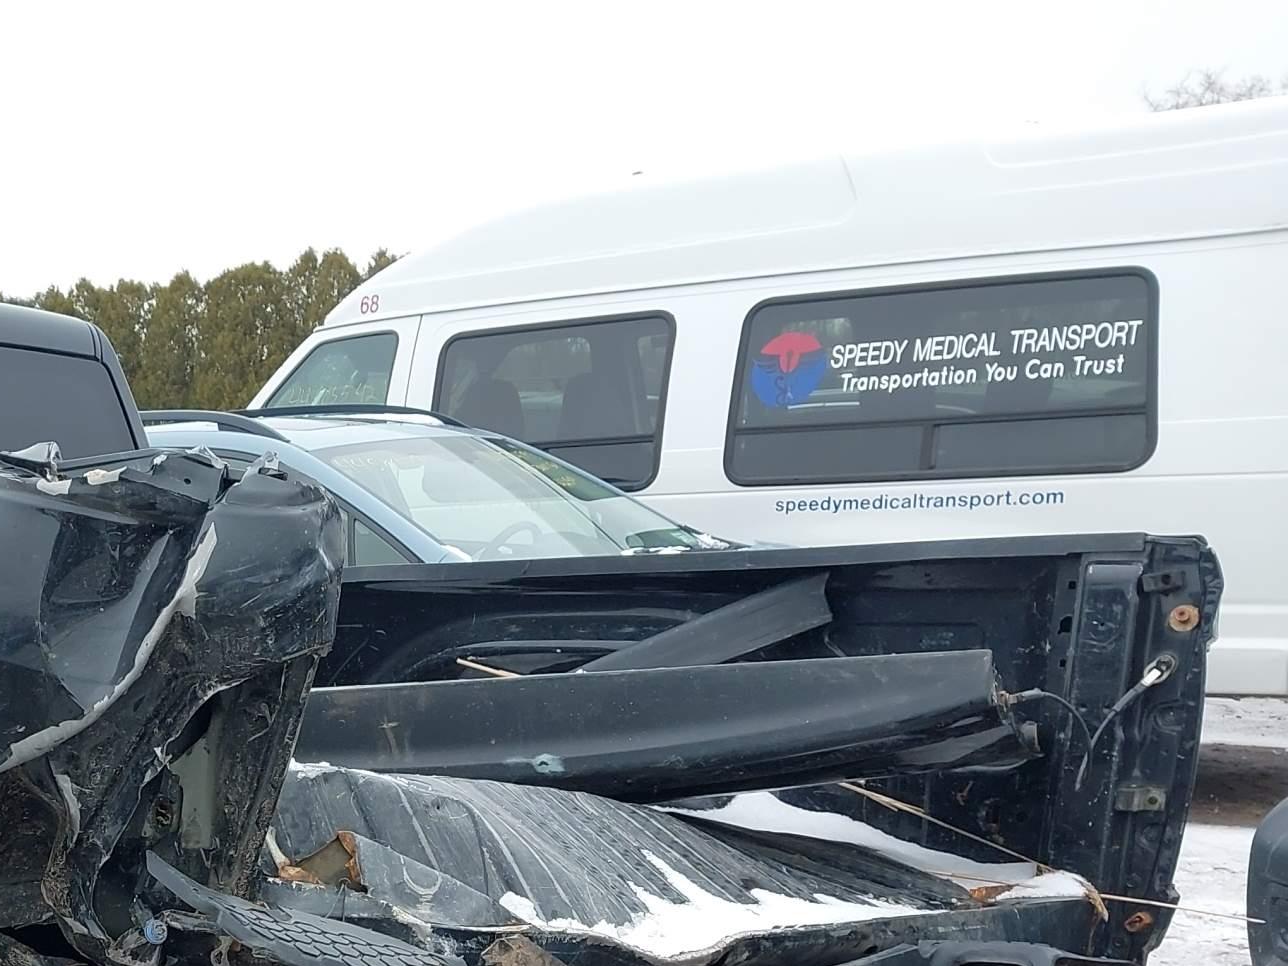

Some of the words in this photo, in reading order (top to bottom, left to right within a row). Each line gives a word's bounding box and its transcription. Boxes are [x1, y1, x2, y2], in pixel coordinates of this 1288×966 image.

[360, 294, 380, 315] 68
[830, 339, 909, 369] SPEEDY
[912, 332, 1001, 363] MEDICAL
[1010, 319, 1144, 355] TRANSPORT
[840, 366, 977, 394] Transportation
[985, 362, 1018, 382] You
[1025, 358, 1065, 380] Can
[1073, 354, 1125, 376] Trust
[774, 489, 1065, 515] speedymedicaltransport.com
